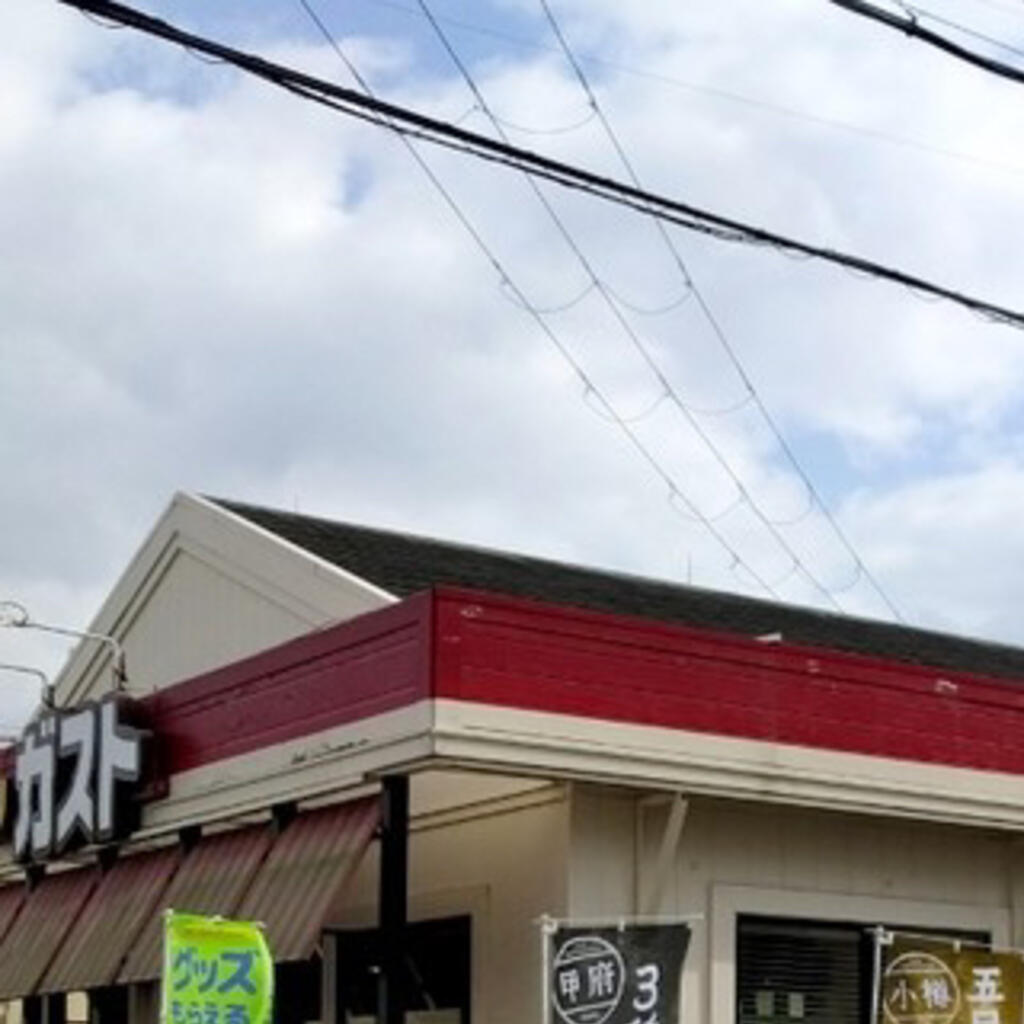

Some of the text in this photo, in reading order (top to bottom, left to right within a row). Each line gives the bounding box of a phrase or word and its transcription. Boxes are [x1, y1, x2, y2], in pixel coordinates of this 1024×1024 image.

[14, 701, 140, 856] ガスト
[172, 946, 261, 995] グッズ
[559, 961, 615, 1003] 甲府
